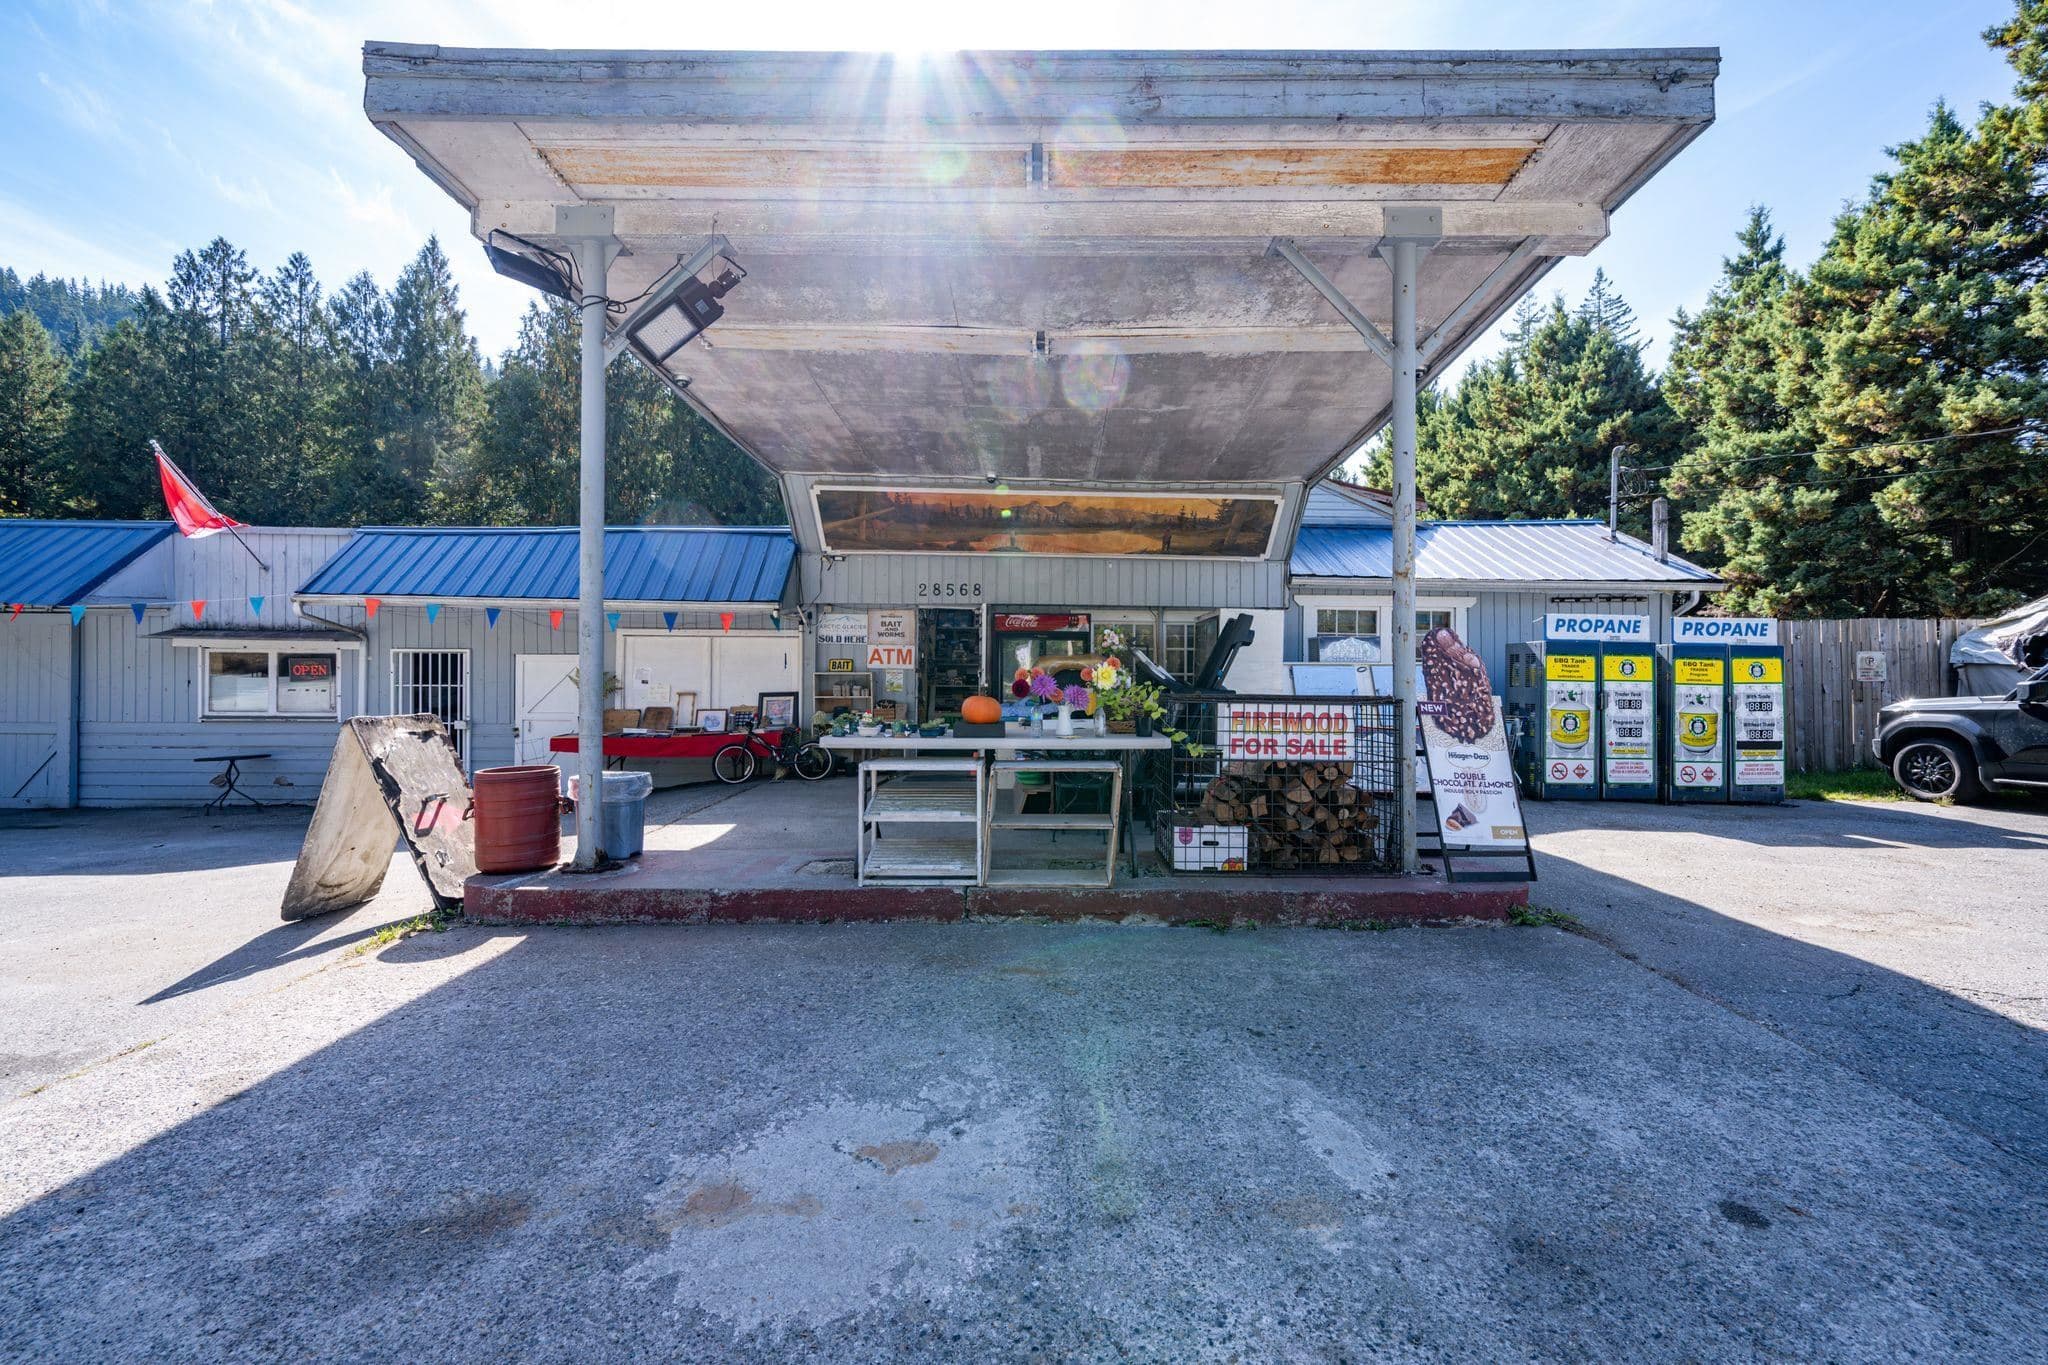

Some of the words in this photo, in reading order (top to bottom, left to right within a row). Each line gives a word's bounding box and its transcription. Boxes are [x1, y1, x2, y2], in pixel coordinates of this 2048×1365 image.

[918, 583, 982, 597] 28568
[1554, 618, 1642, 634] PROPANE
[1681, 621, 1769, 637] PROPANE
[818, 635, 842, 643] SOLD
[844, 635, 867, 643] HERE
[868, 648, 913, 665] ATM
[292, 664, 327, 676] OPEN
[831, 661, 851, 670] BAIT
[1420, 703, 1443, 713] NEW
[1231, 711, 1349, 736] FIREWOOD
[1230, 737, 1279, 755] FOR
[1285, 738, 1348, 756] SALE
[1453, 772, 1486, 781] DOUBLE
[1432, 778, 1475, 788] CHOCOLATE
[1478, 780, 1514, 789] ALMOND
